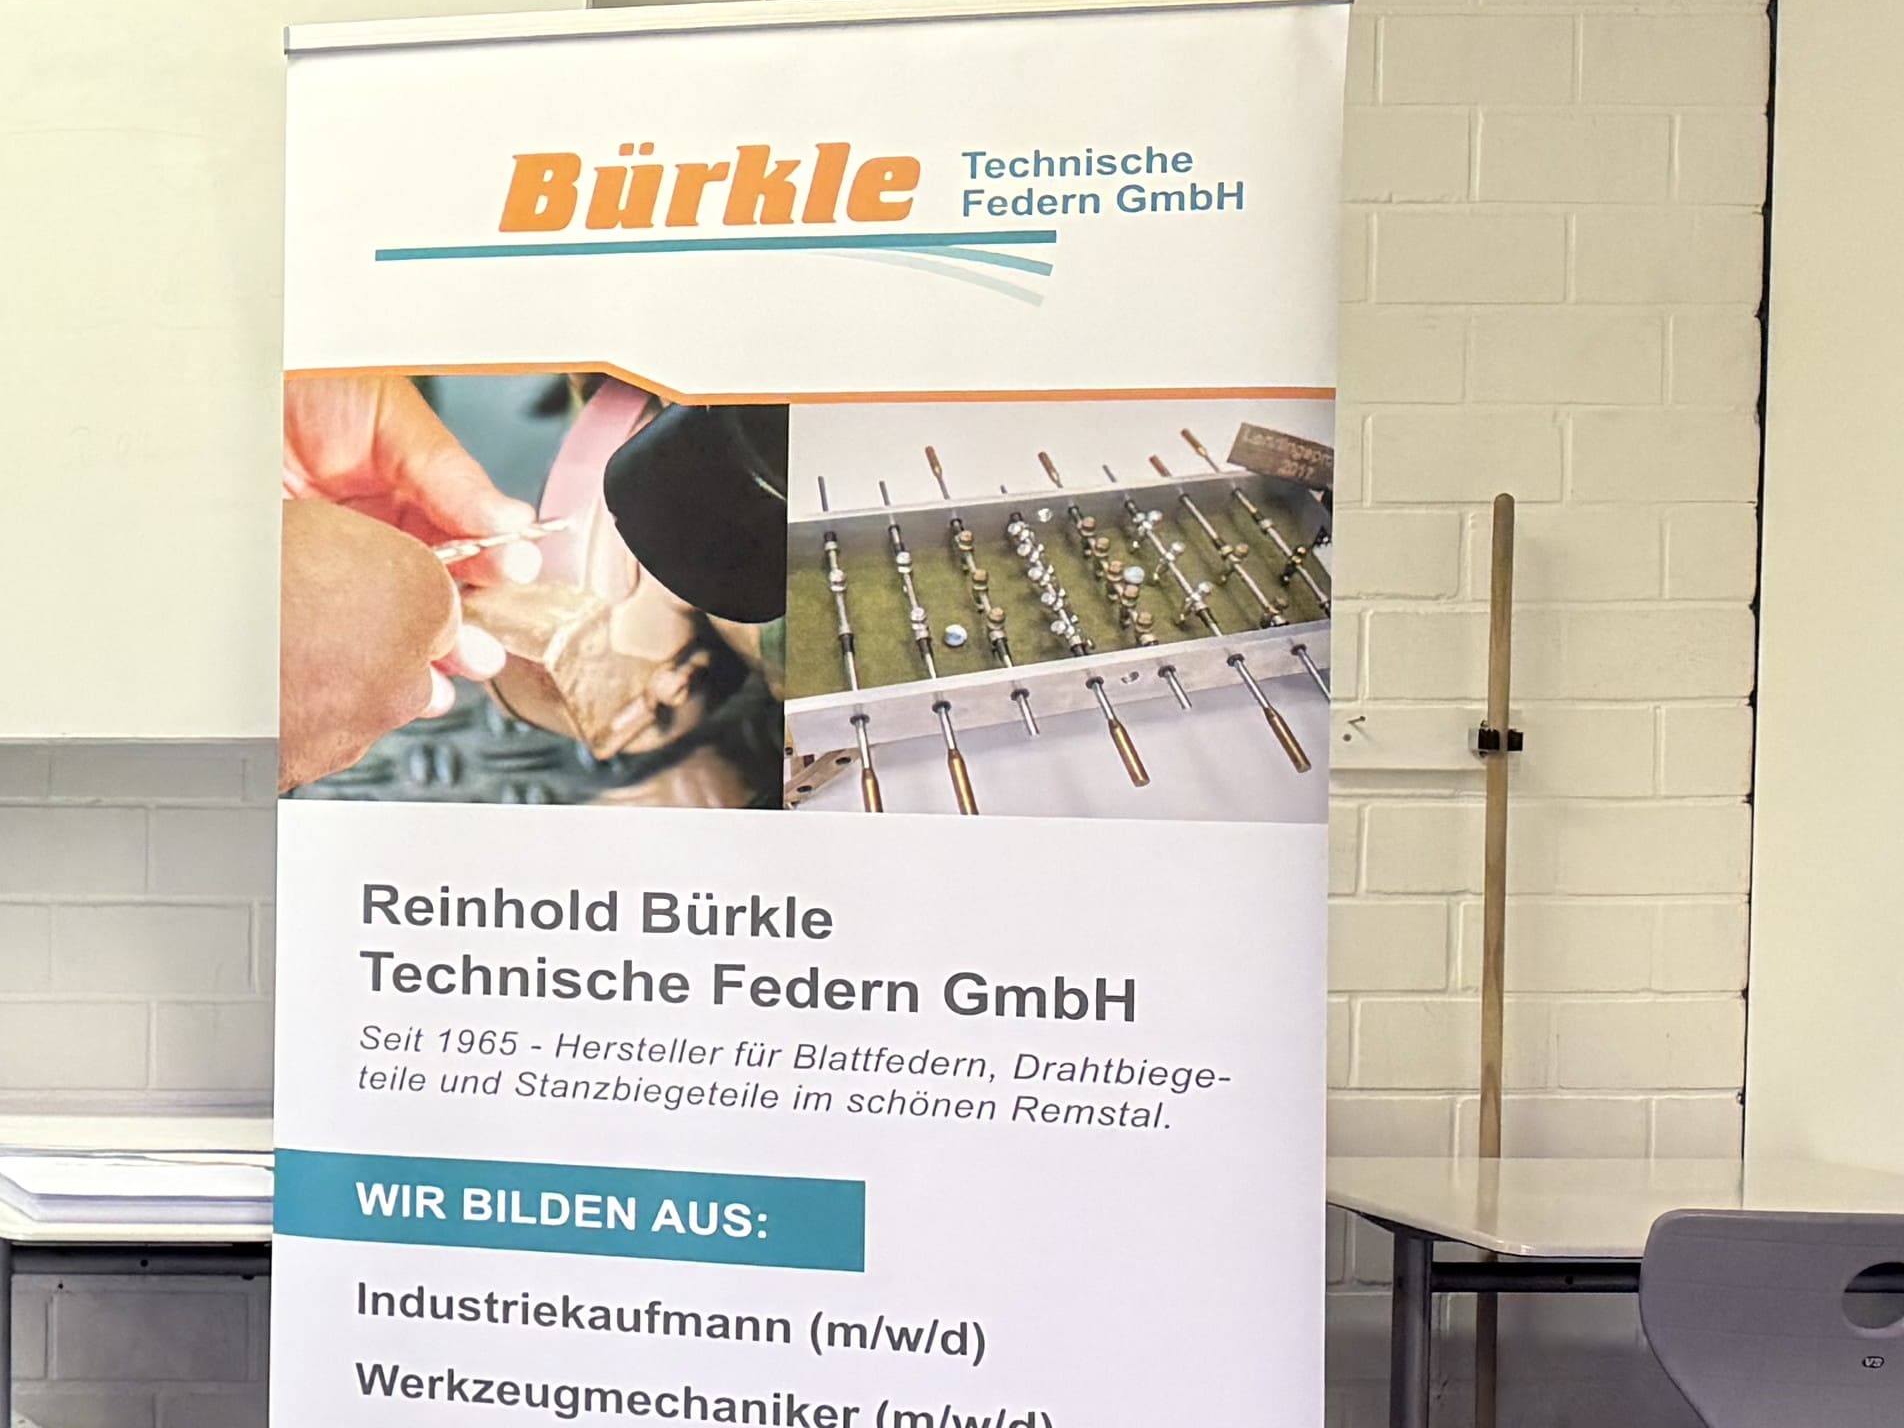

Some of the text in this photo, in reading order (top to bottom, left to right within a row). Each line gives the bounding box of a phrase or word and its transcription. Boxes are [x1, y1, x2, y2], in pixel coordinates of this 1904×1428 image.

[499, 142, 920, 232] Bürkle
[962, 146, 1192, 179] Technische
[963, 181, 1243, 217] Federn GmbH
[364, 884, 832, 939] Reinhold Bürkle
[360, 951, 1134, 1022] Technische Federn GmbH
[360, 1025, 423, 1052] Seit
[440, 1029, 518, 1055] 1965
[556, 1033, 724, 1065] Hersteller
[735, 1041, 782, 1067] für
[794, 1044, 994, 1083] Blattfedern,
[1014, 1054, 1230, 1094] Drahtbiege-
[359, 1066, 1169, 1129] teile und Stanzbiegeteile im schönen Remstal.
[356, 1182, 767, 1238] WIR BILDEN AUS:
[358, 1282, 985, 1366] Industriekaufmann (m/w/d)
